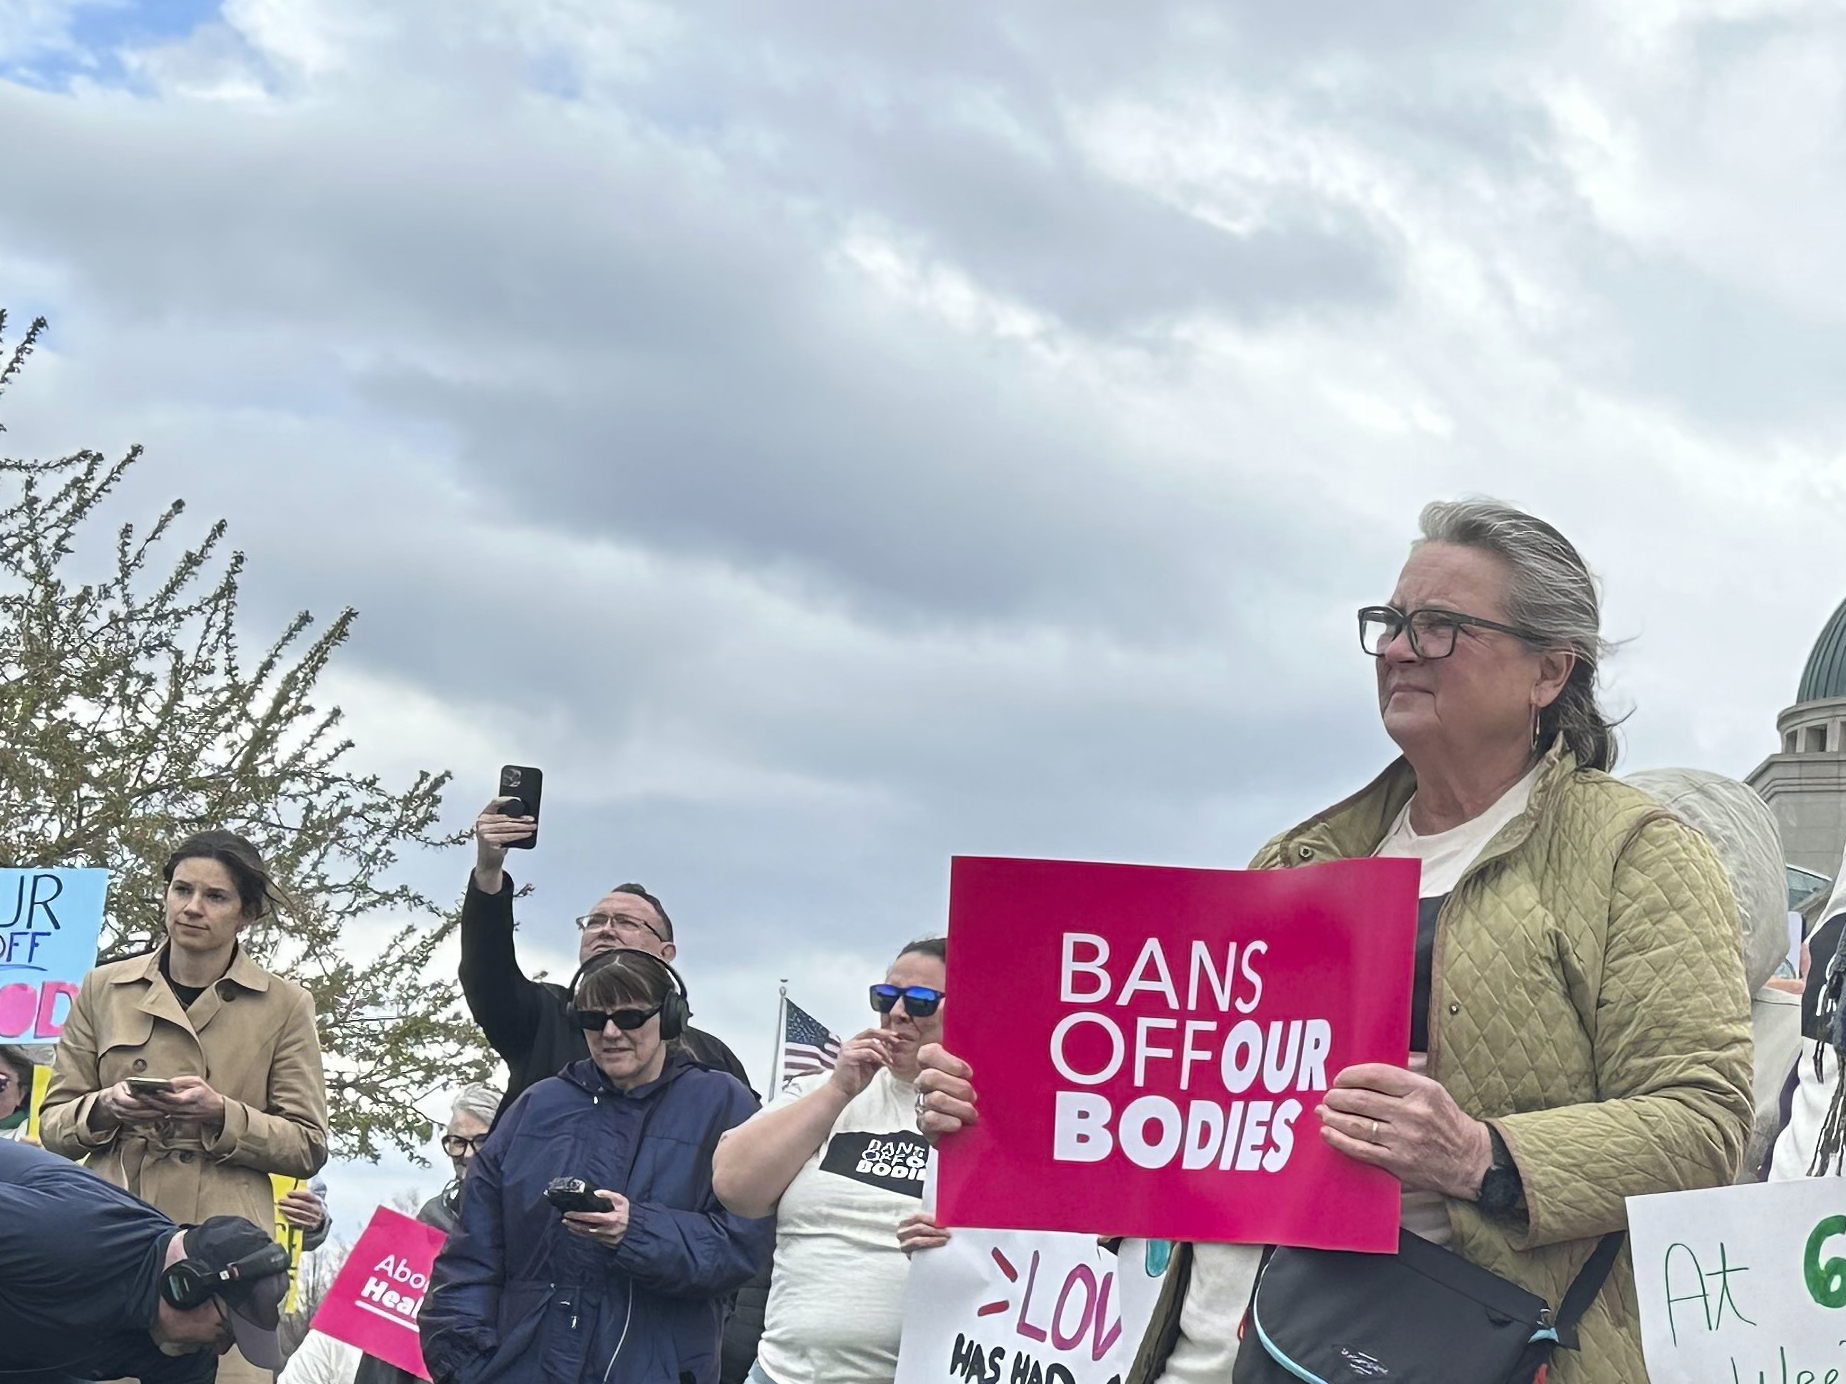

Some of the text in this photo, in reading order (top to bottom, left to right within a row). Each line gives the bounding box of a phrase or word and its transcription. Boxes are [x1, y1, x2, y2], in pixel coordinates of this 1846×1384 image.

[1059, 931, 1268, 1013] BANS
[1053, 1092, 1303, 1173] BODIES
[1665, 1242, 1756, 1346] At
